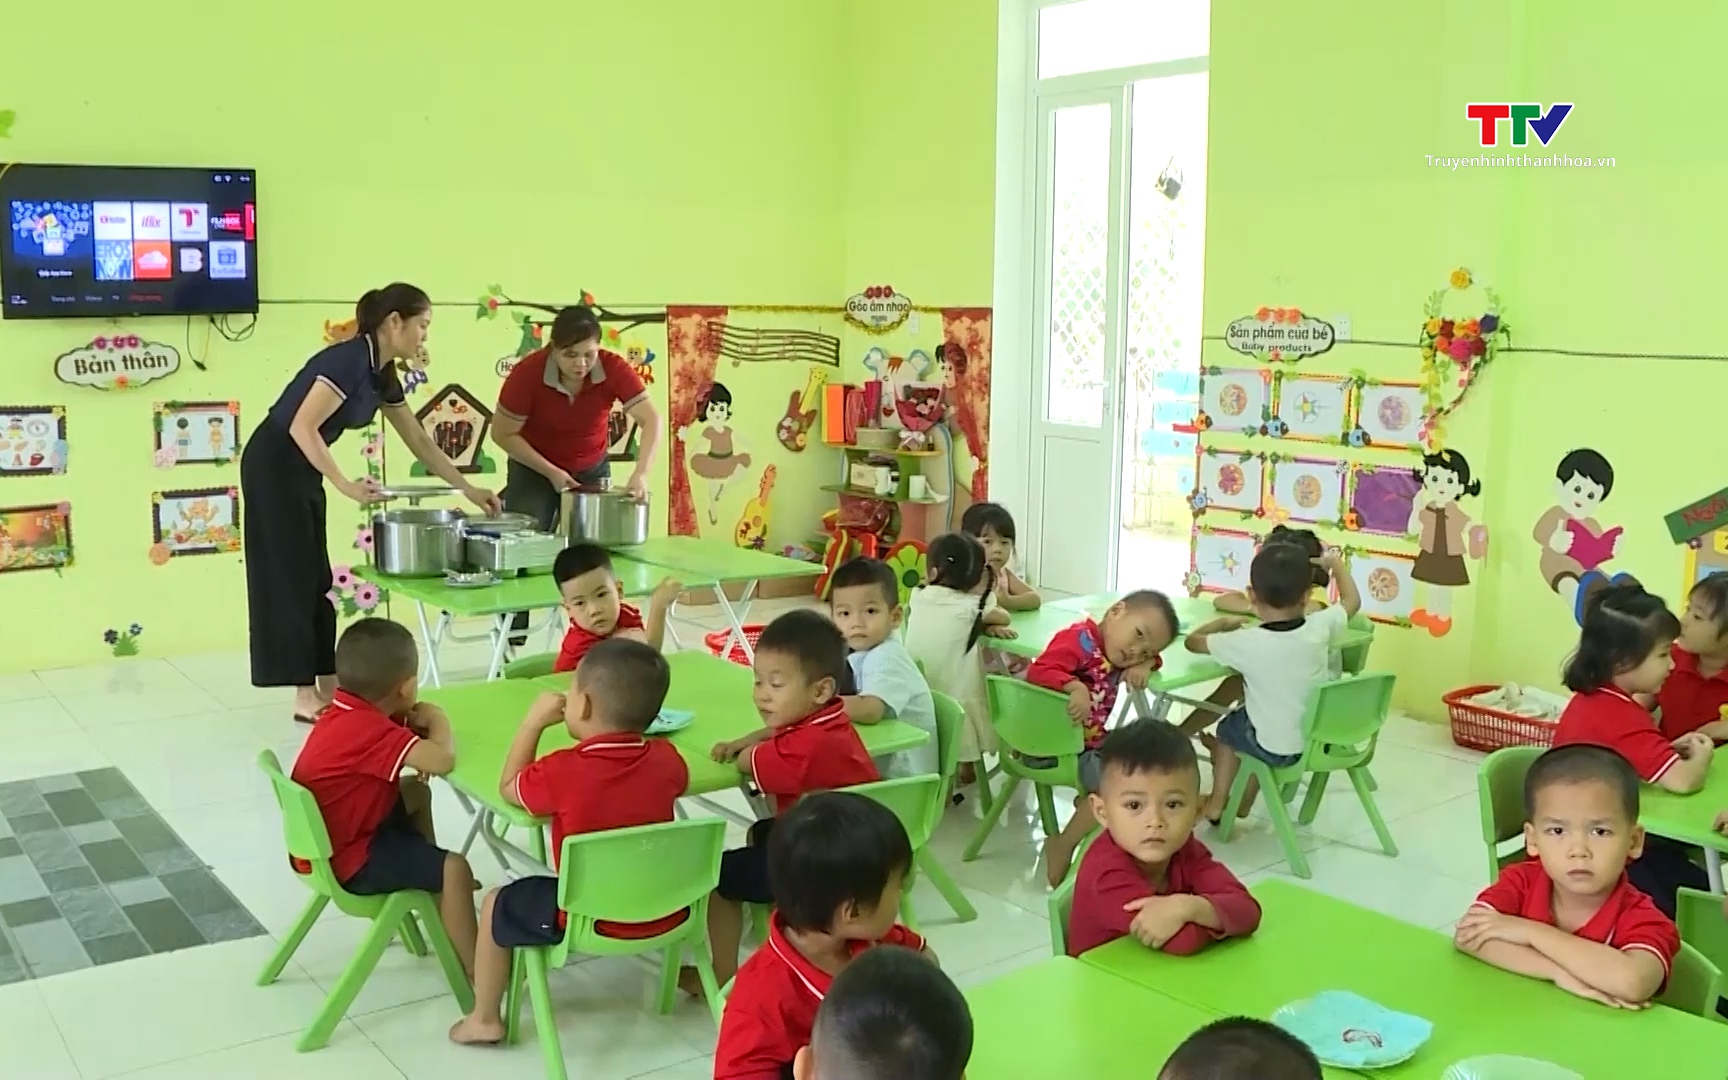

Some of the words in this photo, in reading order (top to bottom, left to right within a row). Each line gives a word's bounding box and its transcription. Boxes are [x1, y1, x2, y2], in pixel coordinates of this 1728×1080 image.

[1312, 326, 1328, 340] bé
[74, 355, 116, 376] Bản
[121, 351, 169, 371] thân
